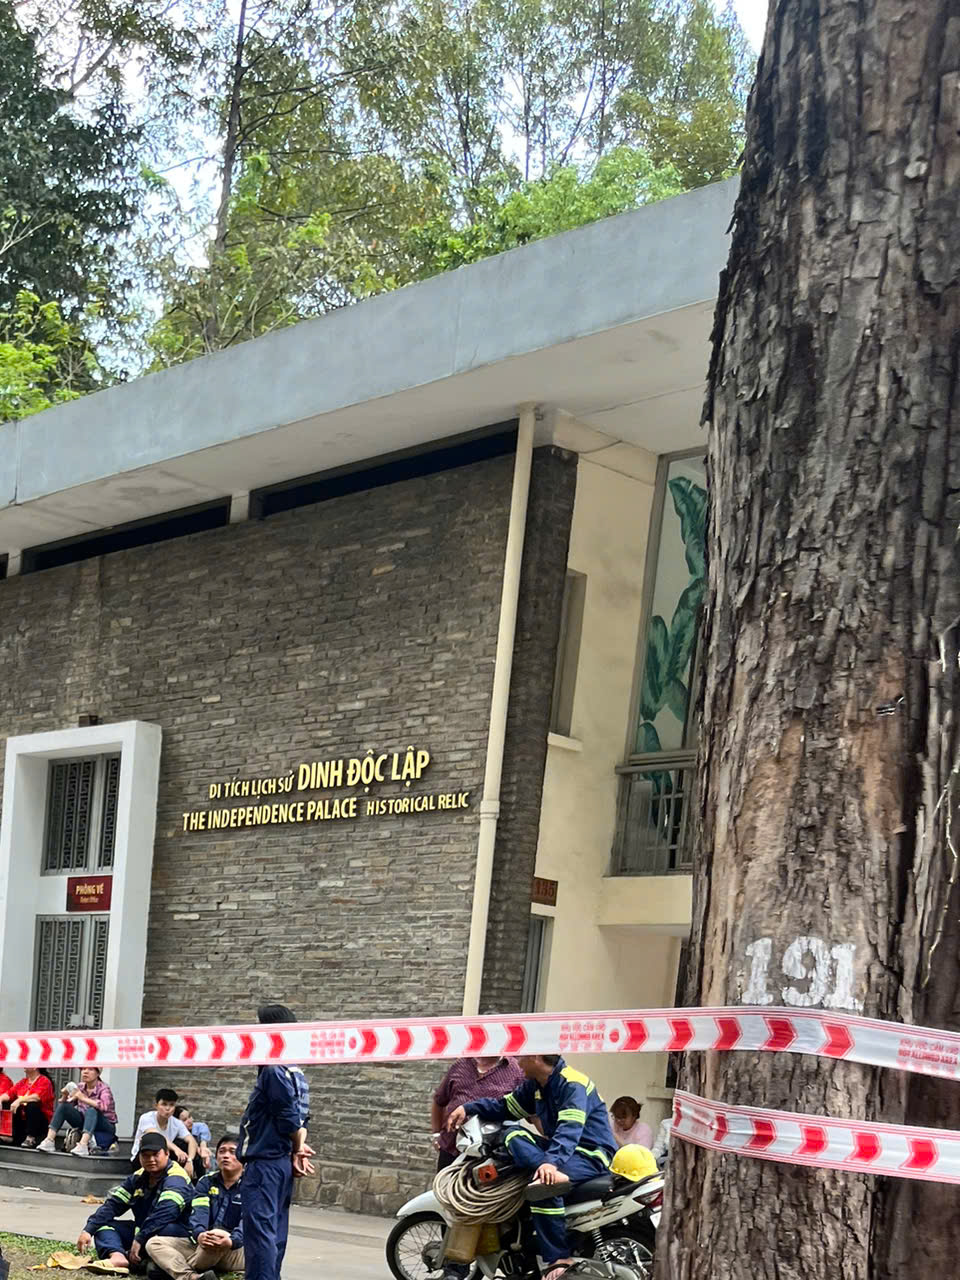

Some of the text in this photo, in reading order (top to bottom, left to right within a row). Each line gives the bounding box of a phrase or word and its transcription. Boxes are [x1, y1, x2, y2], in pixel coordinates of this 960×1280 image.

[209, 745, 430, 799] DI TÍCH LỊCH SỬ DINH ĐỘC LẬP
[182, 791, 469, 831] THE INDEPENDENCE PALACE HISTORICAL RELIC
[742, 935, 865, 1011] 191
